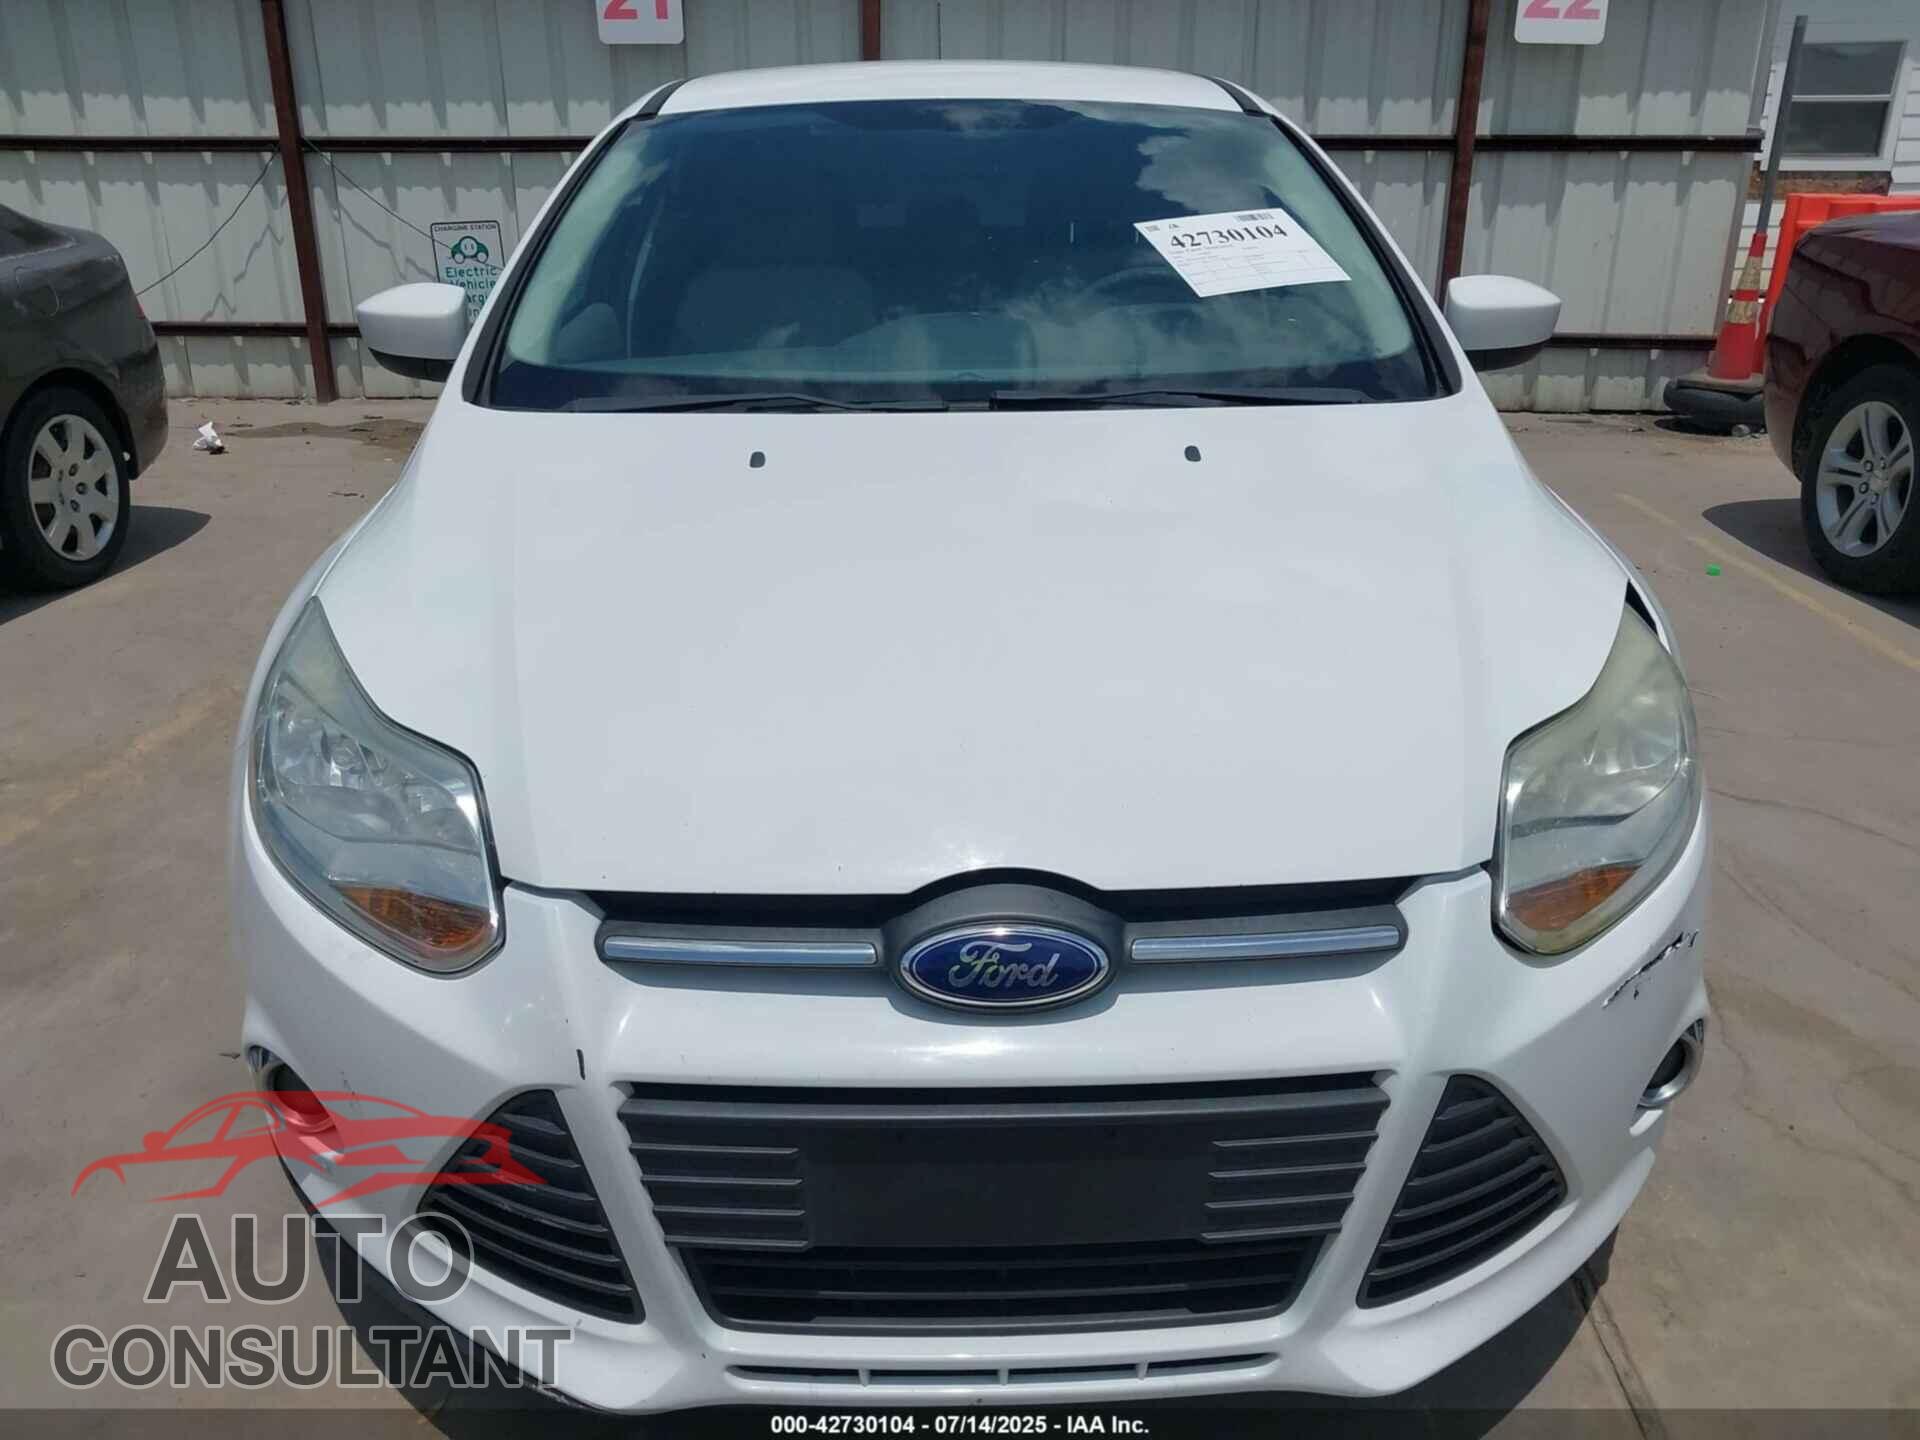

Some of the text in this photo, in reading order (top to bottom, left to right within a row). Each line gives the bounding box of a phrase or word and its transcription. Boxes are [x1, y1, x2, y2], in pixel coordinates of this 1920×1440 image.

[1170, 224, 1288, 248] 42730104
[446, 265, 497, 278] Electric
[949, 940, 1059, 988] Ford
